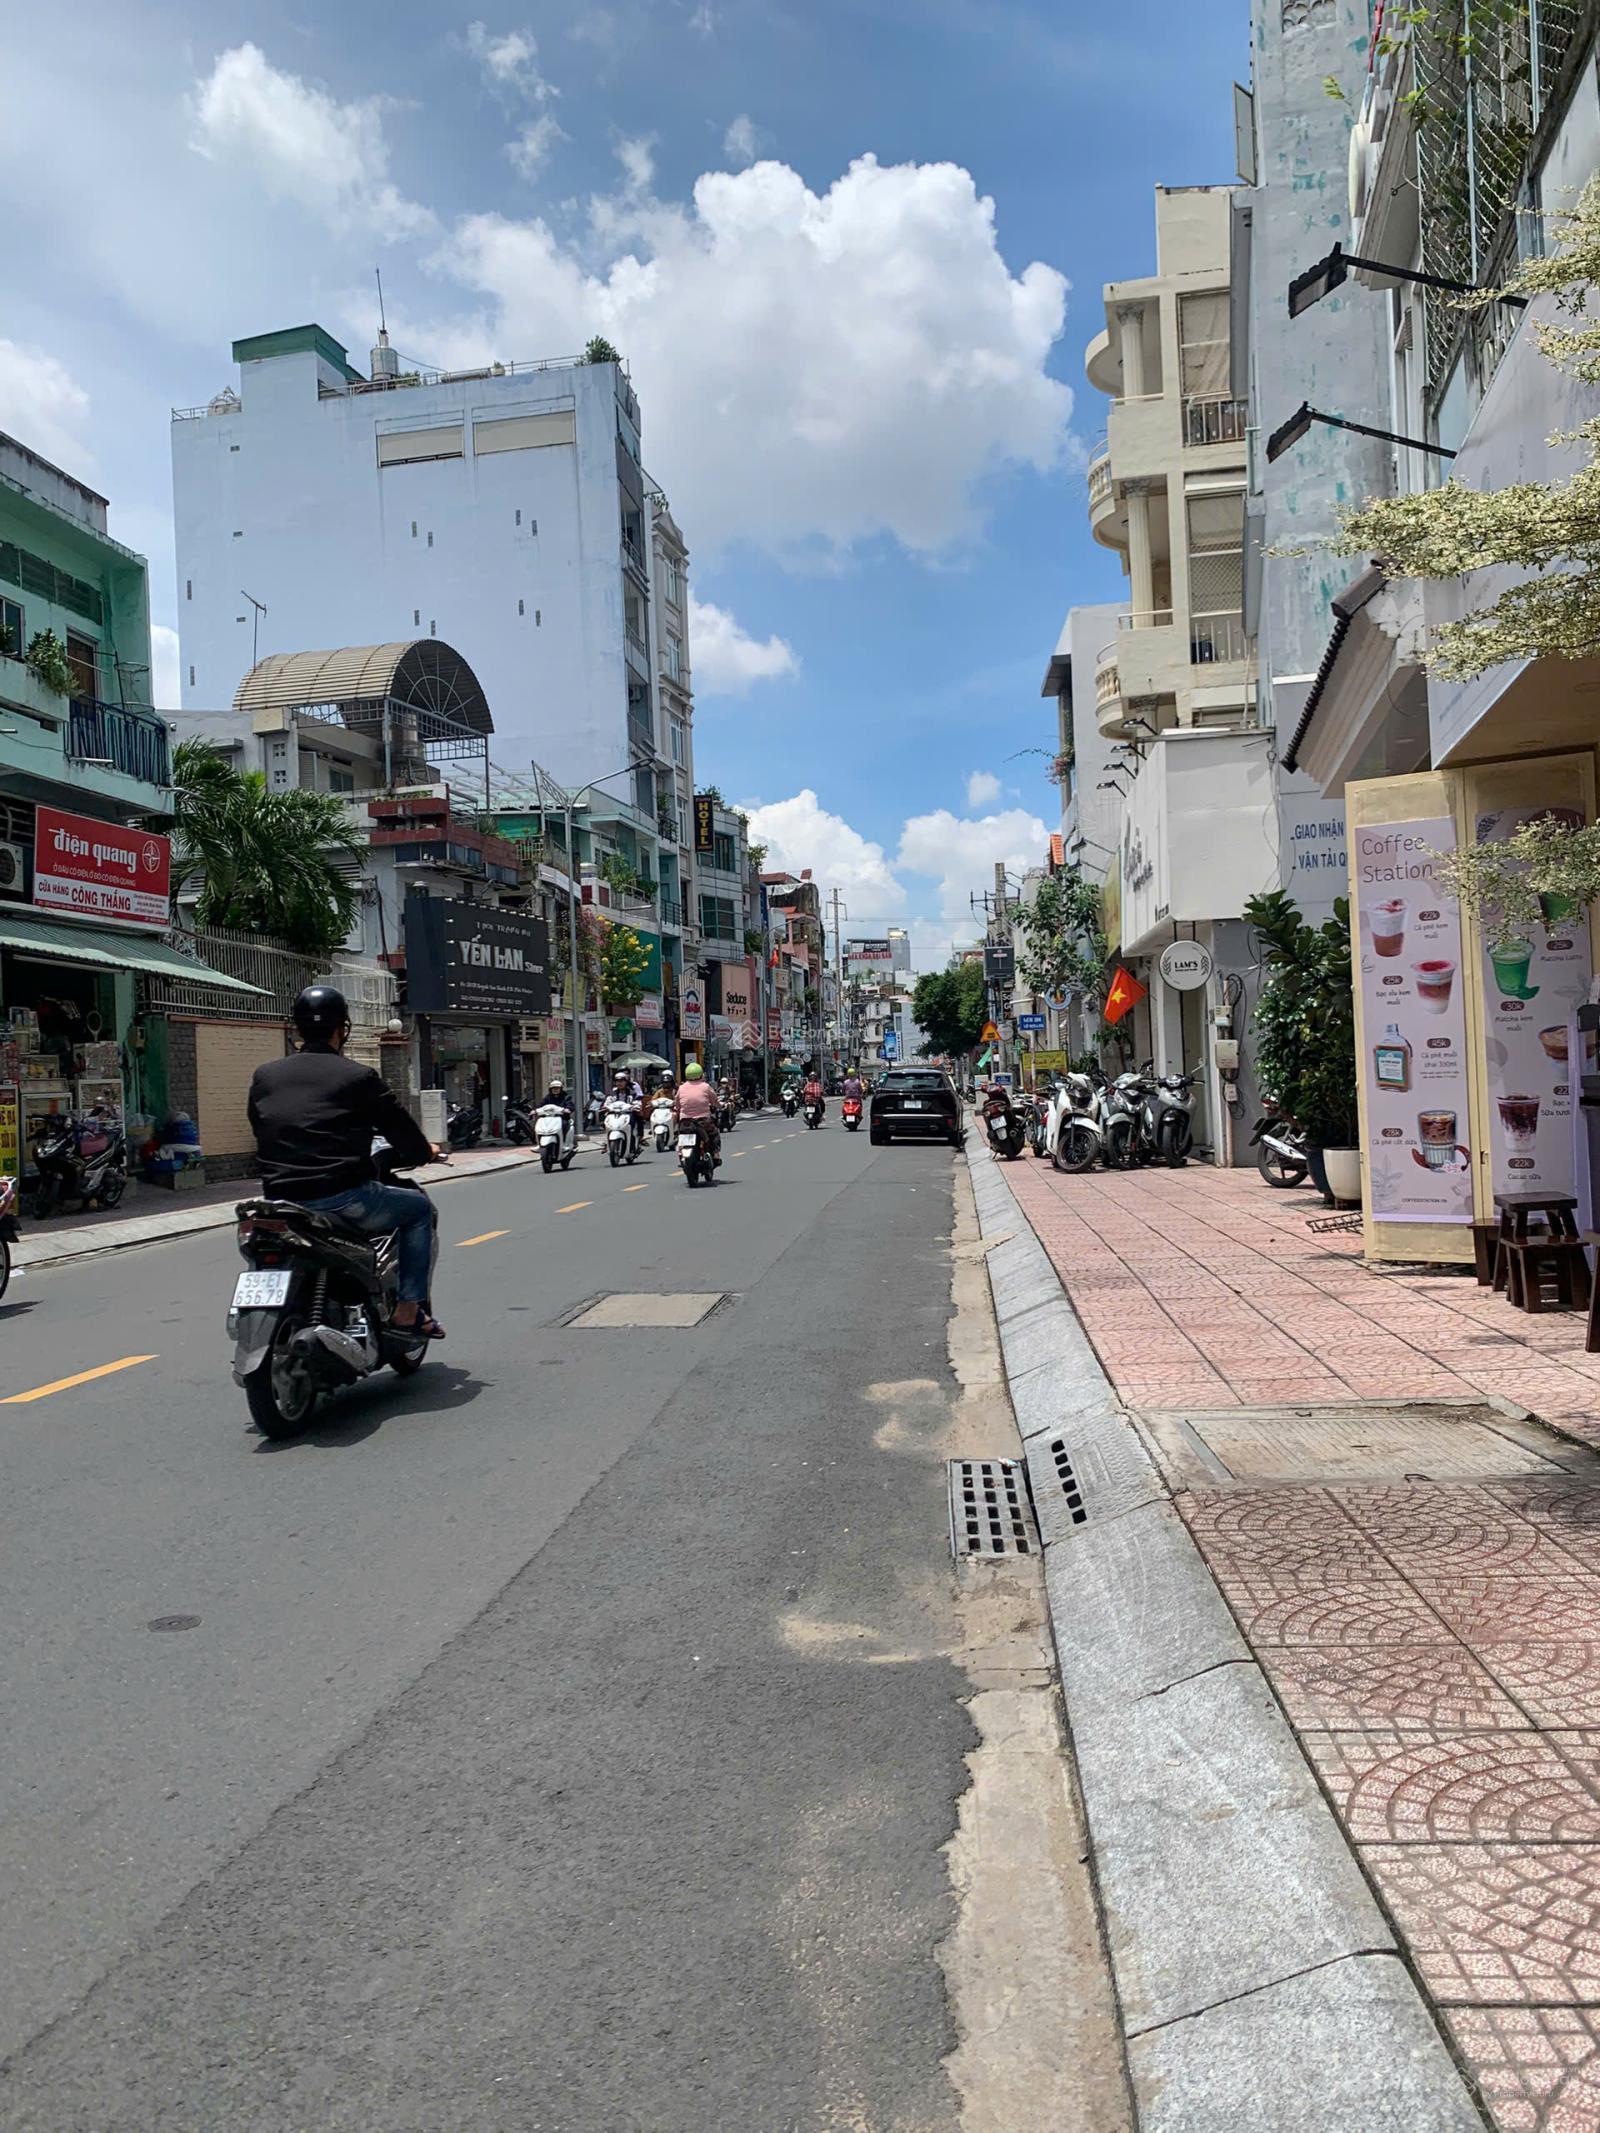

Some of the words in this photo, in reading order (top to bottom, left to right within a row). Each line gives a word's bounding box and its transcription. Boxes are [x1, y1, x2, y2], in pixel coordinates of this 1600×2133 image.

[698, 802, 709, 846] HOTEL
[1295, 824, 1316, 839] GIAO
[1319, 818, 1344, 840] NHẬN
[48, 828, 89, 857] điện
[93, 844, 137, 873] quang
[1362, 834, 1424, 856] Coffee
[1299, 851, 1318, 872] VẬN
[1321, 848, 1336, 867] TẢI
[1363, 862, 1432, 883] Station
[52, 882, 69, 896] HÀNG
[72, 886, 98, 905] CÔNG
[101, 889, 131, 911] THẮNG
[459, 934, 492, 967] YẾN
[727, 991, 746, 1005] Seduce
[244, 1273, 280, 1288] 59-E1
[236, 1290, 284, 1305] 656.78
